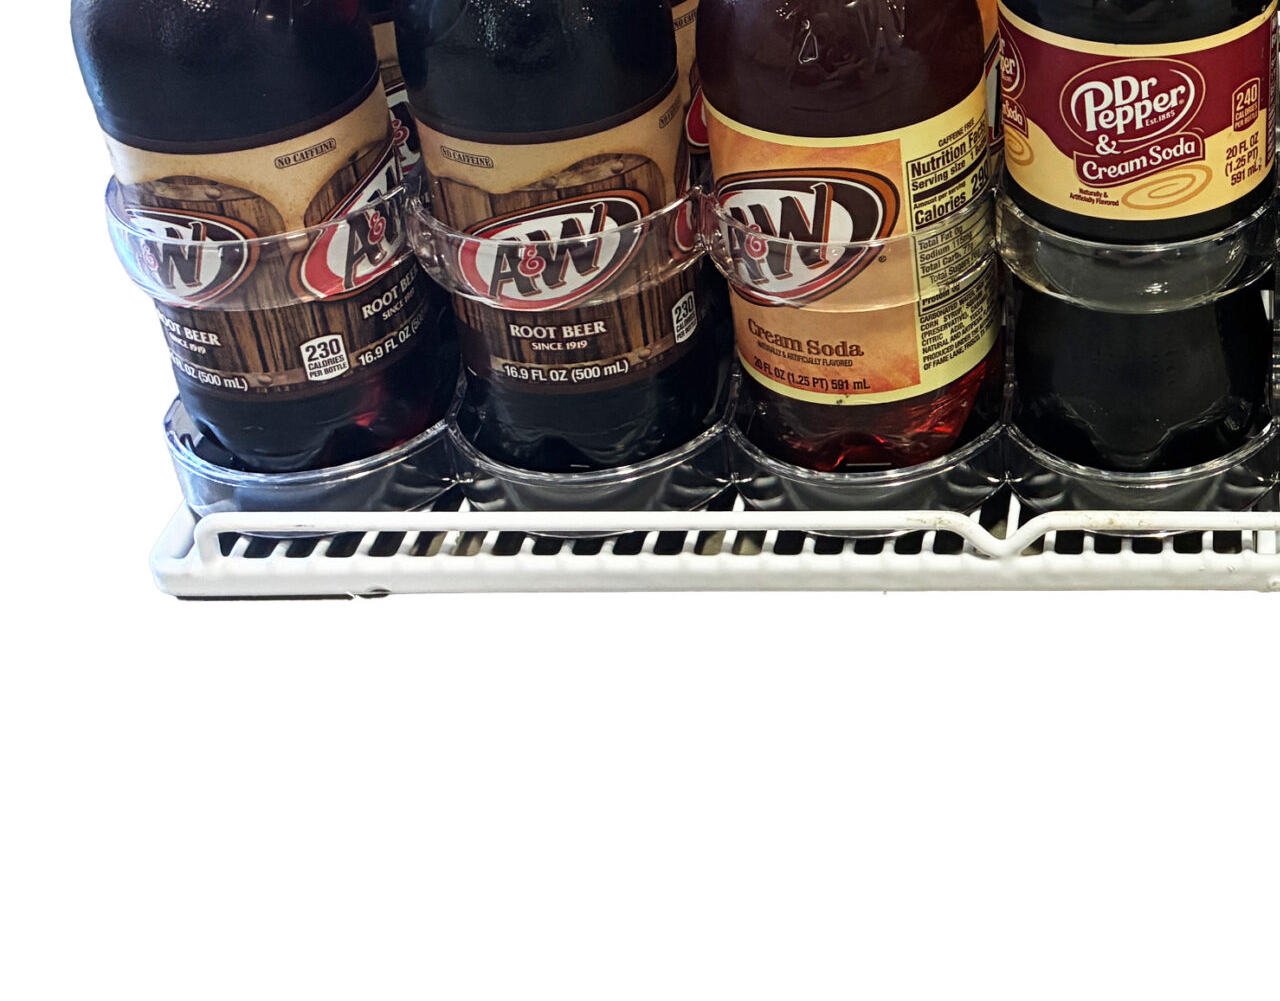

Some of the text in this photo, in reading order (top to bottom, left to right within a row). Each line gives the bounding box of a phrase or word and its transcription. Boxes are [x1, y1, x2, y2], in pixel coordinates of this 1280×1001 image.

[1112, 75, 1157, 107] Dr
[1236, 83, 1257, 112] 240
[1070, 81, 1186, 135] Pepper
[938, 126, 964, 147] CAFFEINE
[1095, 134, 1121, 155] &
[1226, 131, 1259, 161] 20 FL OZ
[276, 139, 336, 168] NO CAFFEINE
[911, 142, 967, 179] Nutrition
[1082, 137, 1196, 180] Cream Soda
[912, 160, 966, 191] Serving size
[1225, 155, 1246, 177] (1.25
[1231, 168, 1246, 186] 591
[914, 192, 967, 225] Calories
[489, 201, 608, 298] A&W
[919, 238, 939, 250] Total
[940, 232, 953, 240] Fat
[920, 244, 950, 263] Sodium
[921, 262, 940, 275] Total
[931, 271, 947, 284] Total
[361, 285, 398, 319] ROOT
[922, 288, 950, 306] Protein
[381, 300, 404, 322] SINCE
[675, 295, 693, 325] 230
[920, 302, 958, 323] CARBONATED
[183, 327, 221, 347] BEER
[509, 321, 607, 339] ROOT BEER
[920, 320, 939, 332] CORN
[357, 326, 412, 366] 16.9 FL OZ
[531, 340, 588, 351] SINCE 1919
[748, 318, 864, 357] Cream Soda
[922, 333, 943, 347] CITRIC
[922, 338, 950, 355] NATURAL
[950, 332, 961, 342] AND
[305, 338, 341, 362] 230
[923, 344, 954, 363] PRODUCED
[307, 355, 345, 371] CALORIES
[309, 361, 348, 379] PER BOTTLE
[504, 359, 629, 383] 16.9 FL OZ (500 mL)
[822, 358, 853, 367] FLAVORED
[923, 362, 931, 371] OF
[932, 354, 949, 367] FAME
[198, 370, 221, 387] (500
[223, 378, 249, 392] mL)
[763, 362, 870, 391] FL OZ (1.25 PT) 591 mL
